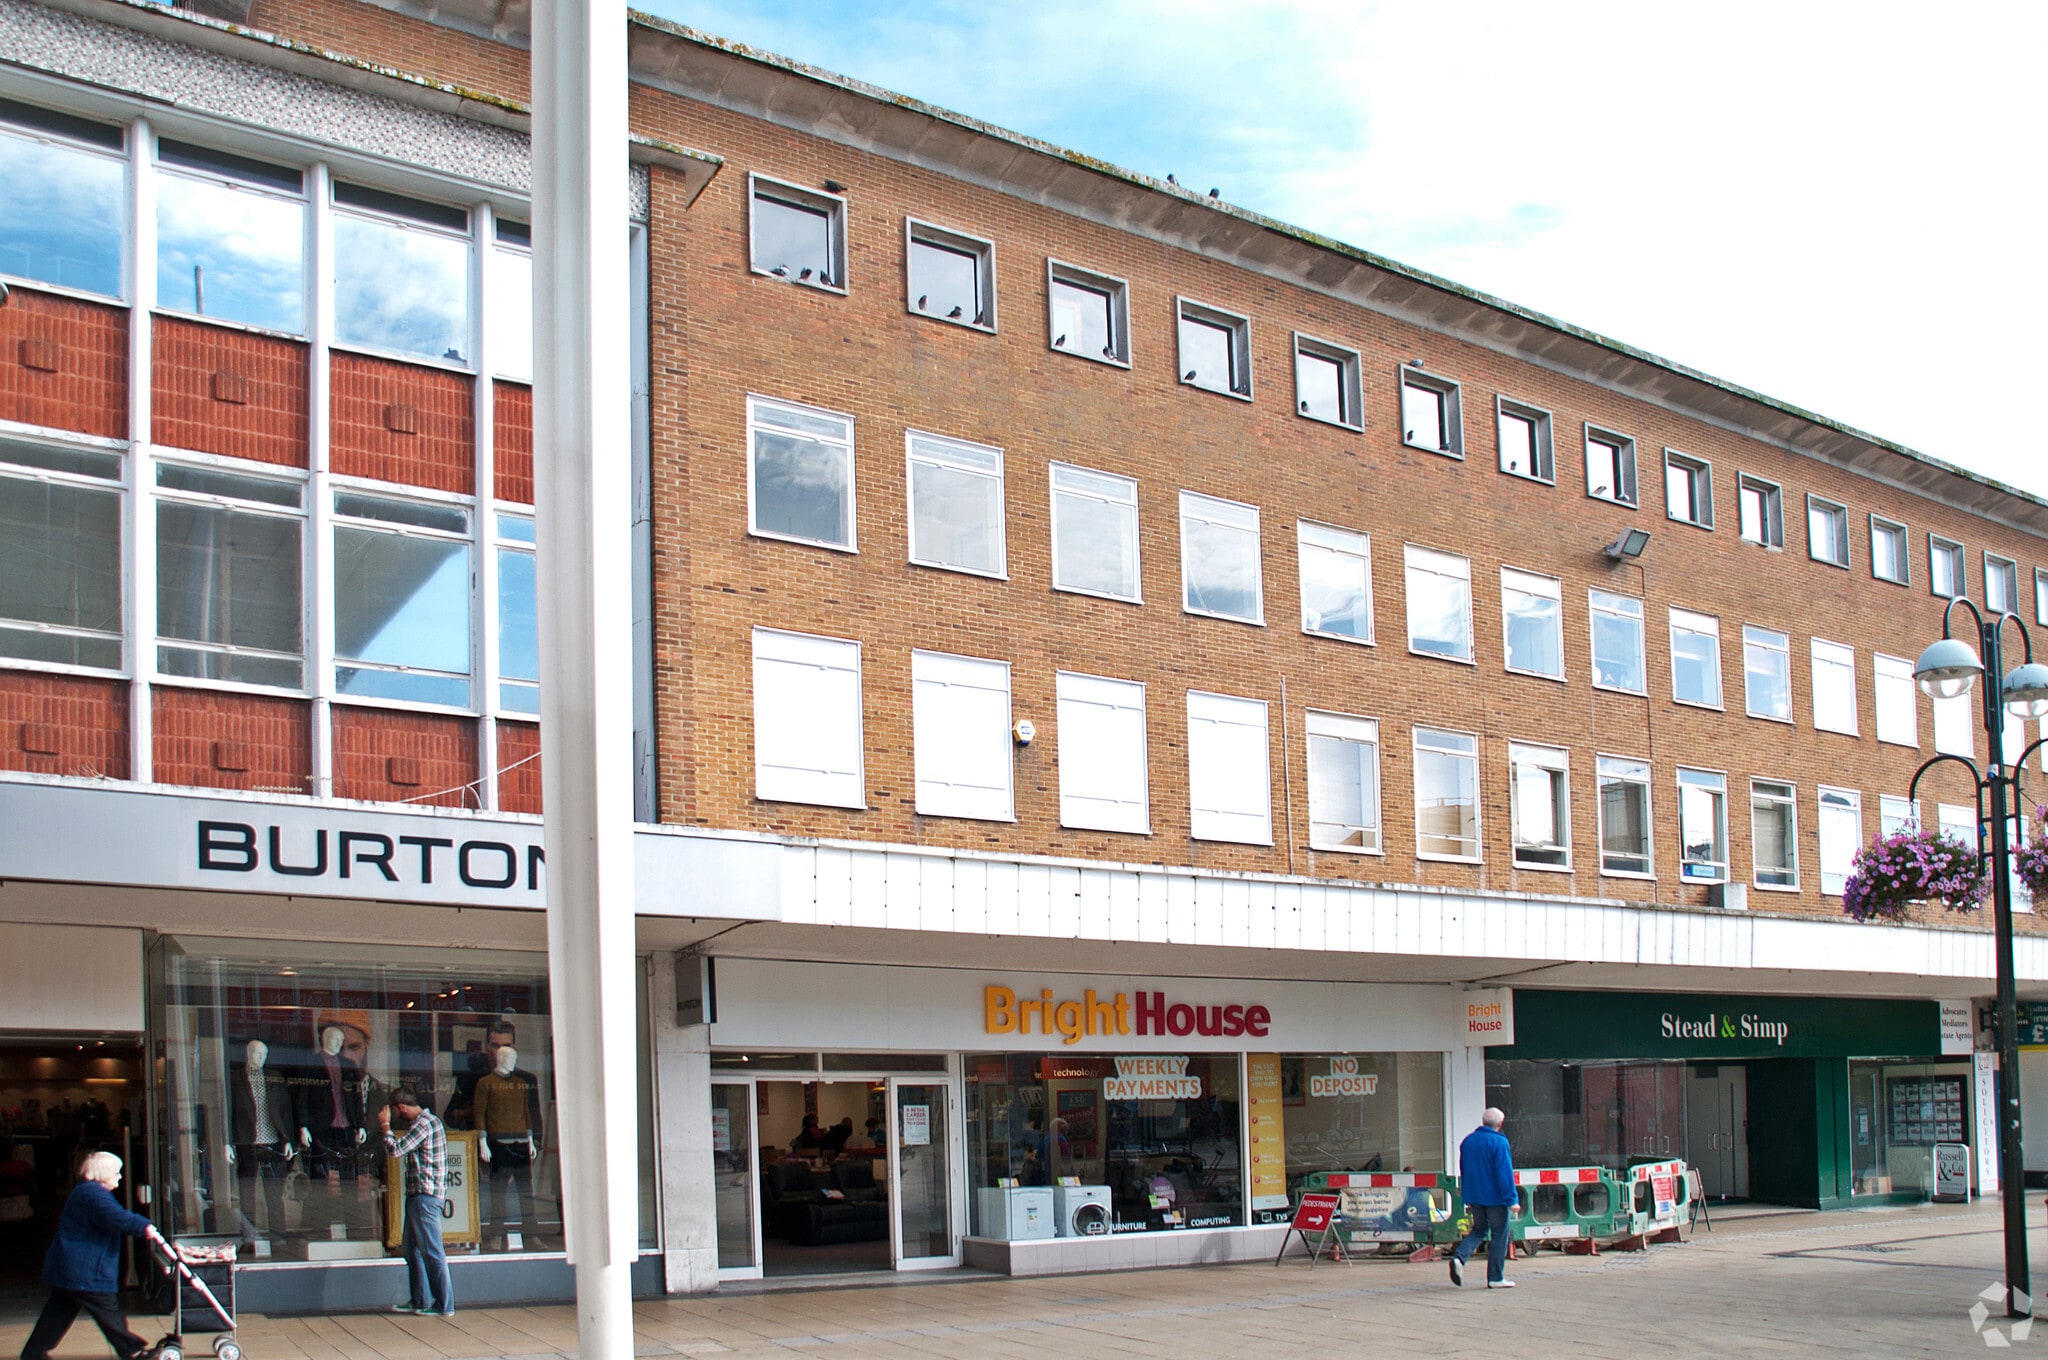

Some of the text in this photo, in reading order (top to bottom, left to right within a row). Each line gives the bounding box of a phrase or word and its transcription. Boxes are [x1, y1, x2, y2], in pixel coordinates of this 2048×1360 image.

[1468, 1002, 1502, 1017] Bright
[1942, 1007, 1968, 1015] Advocates
[1469, 1020, 1502, 1032] House
[1661, 1012, 1717, 1038] Stead
[1721, 1014, 1736, 1038] &
[1941, 1019, 1968, 1027] Mediators
[1955, 1032, 1973, 1041] Agents
[1118, 1058, 1187, 1075] WEEKLY
[1332, 1059, 1356, 1073] NO
[1053, 1068, 1099, 1078] technology
[1106, 1079, 1199, 1097] PAYMENTS
[1313, 1077, 1376, 1094] DEPOSIT
[1981, 1077, 1990, 1175] SOLICITORS
[1937, 1150, 1964, 1161] Russell
[1938, 1162, 1952, 1181] &
[1301, 1199, 1337, 1209] PEDESTRIANS
[1108, 1221, 1147, 1232] URNITURE
[1190, 1216, 1231, 1227] COMPUTING
